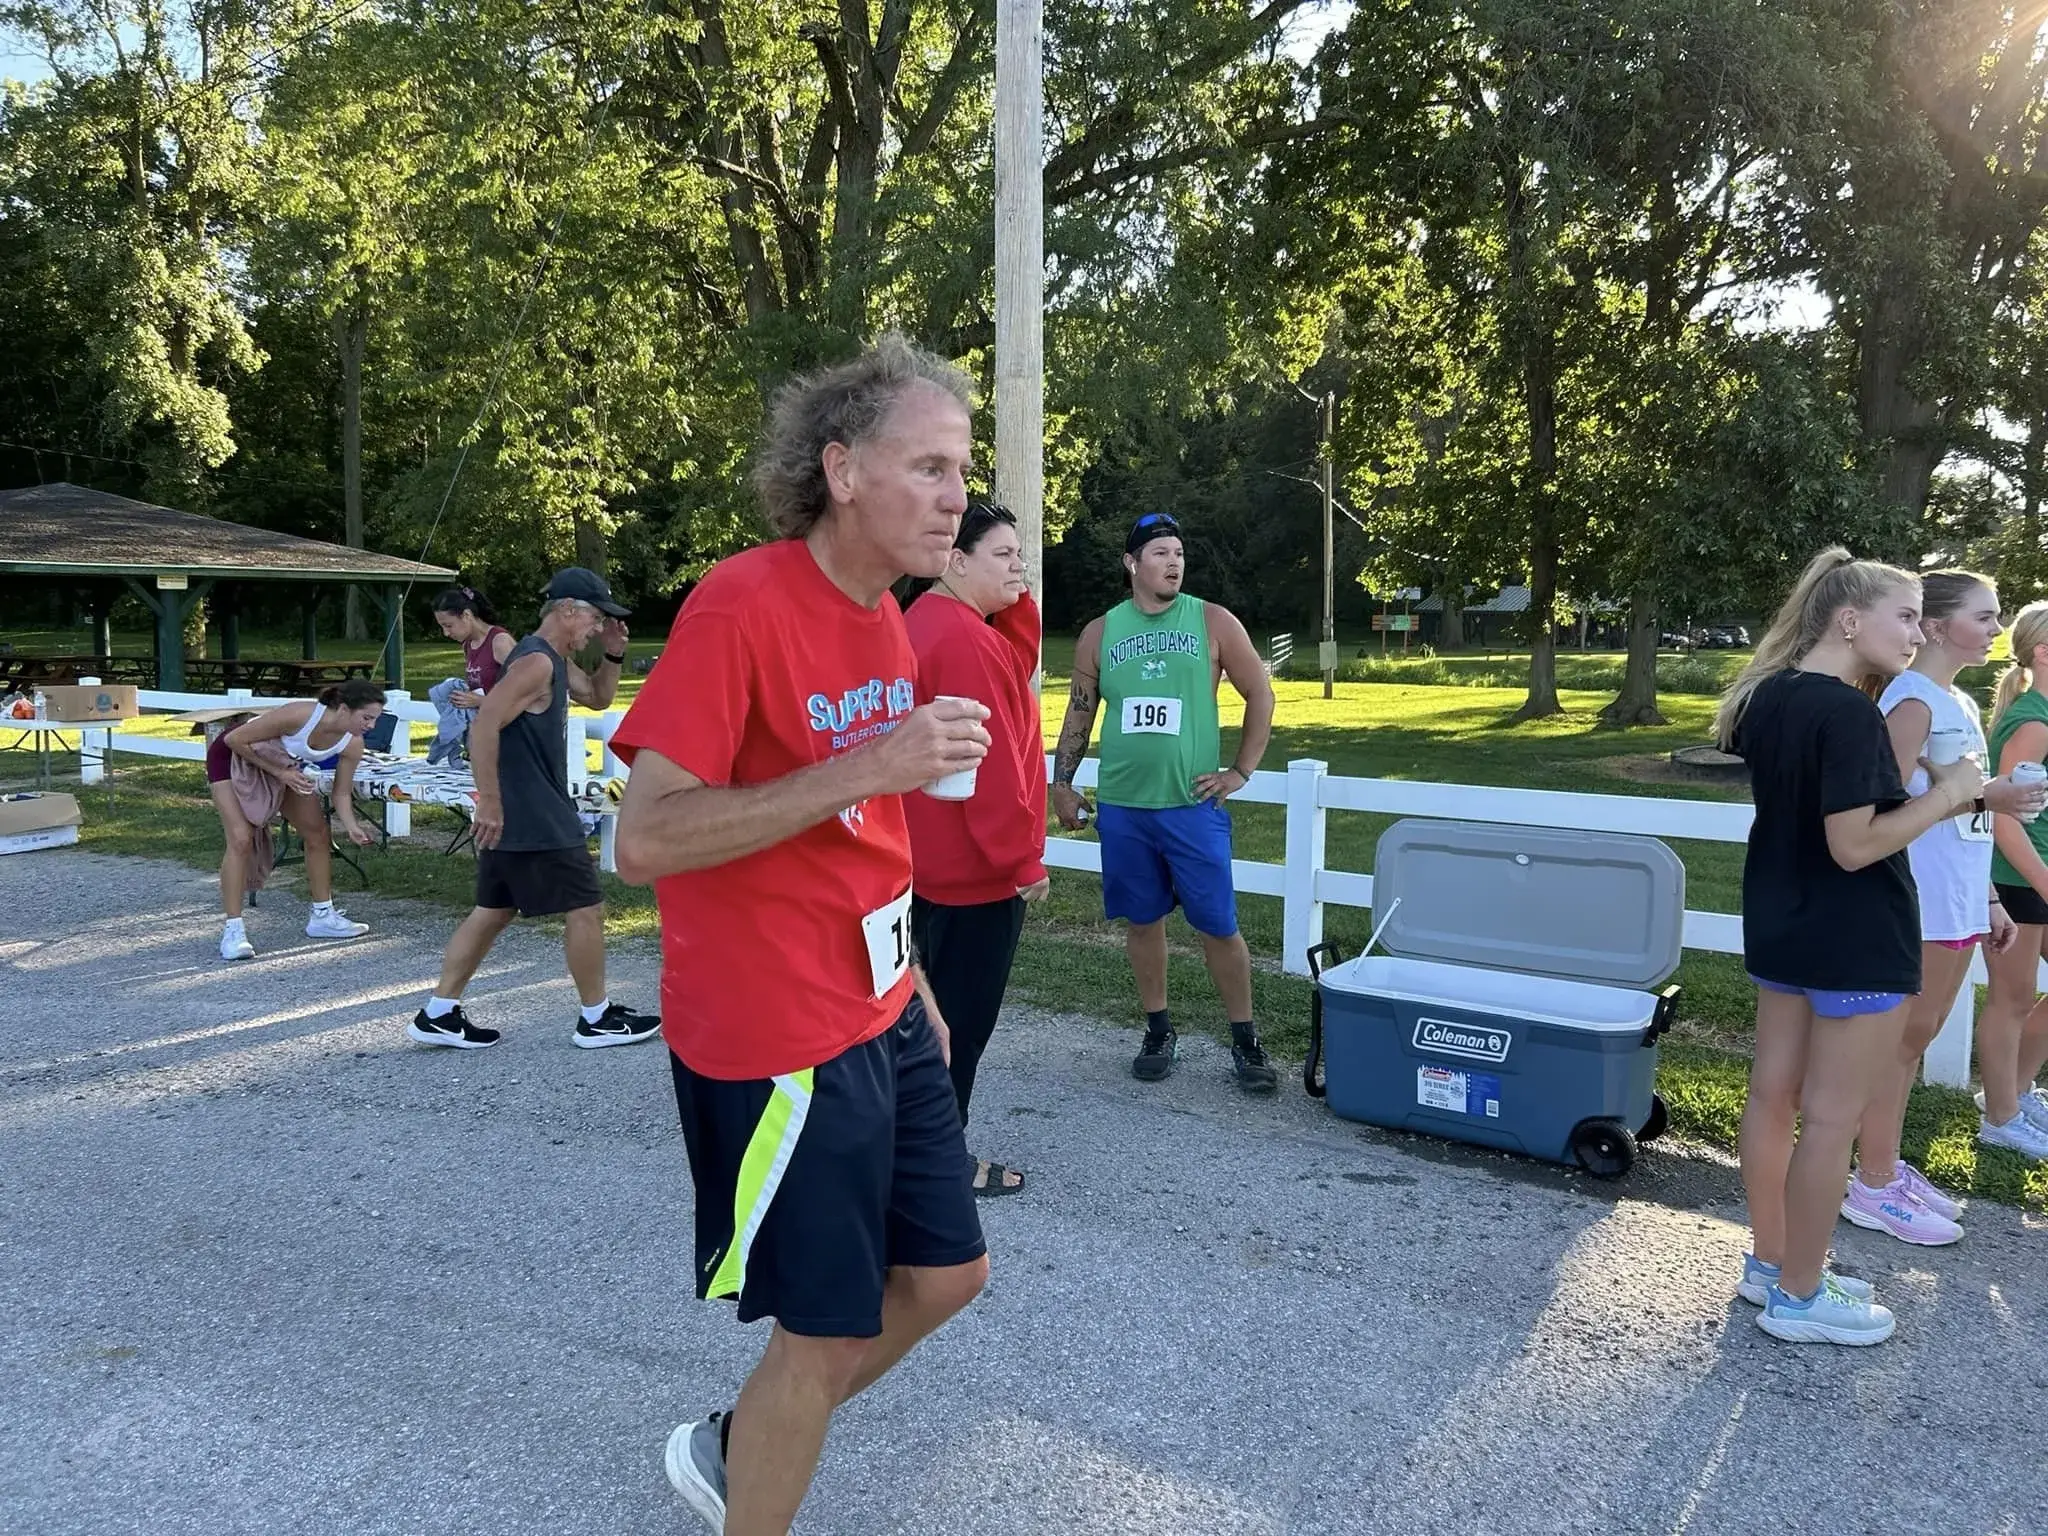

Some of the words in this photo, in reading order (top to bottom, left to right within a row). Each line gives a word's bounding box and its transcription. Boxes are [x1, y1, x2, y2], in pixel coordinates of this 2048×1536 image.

[1108, 632, 1156, 672] NOTRE
[1156, 630, 1201, 661] DAME
[807, 679, 884, 733] SUPER
[1133, 704, 1167, 727] 196
[832, 728, 869, 749] BUTLER
[1971, 809, 1993, 834] 20
[1423, 1023, 1486, 1049] Coleman
[1879, 1202, 1913, 1224] HOKA
